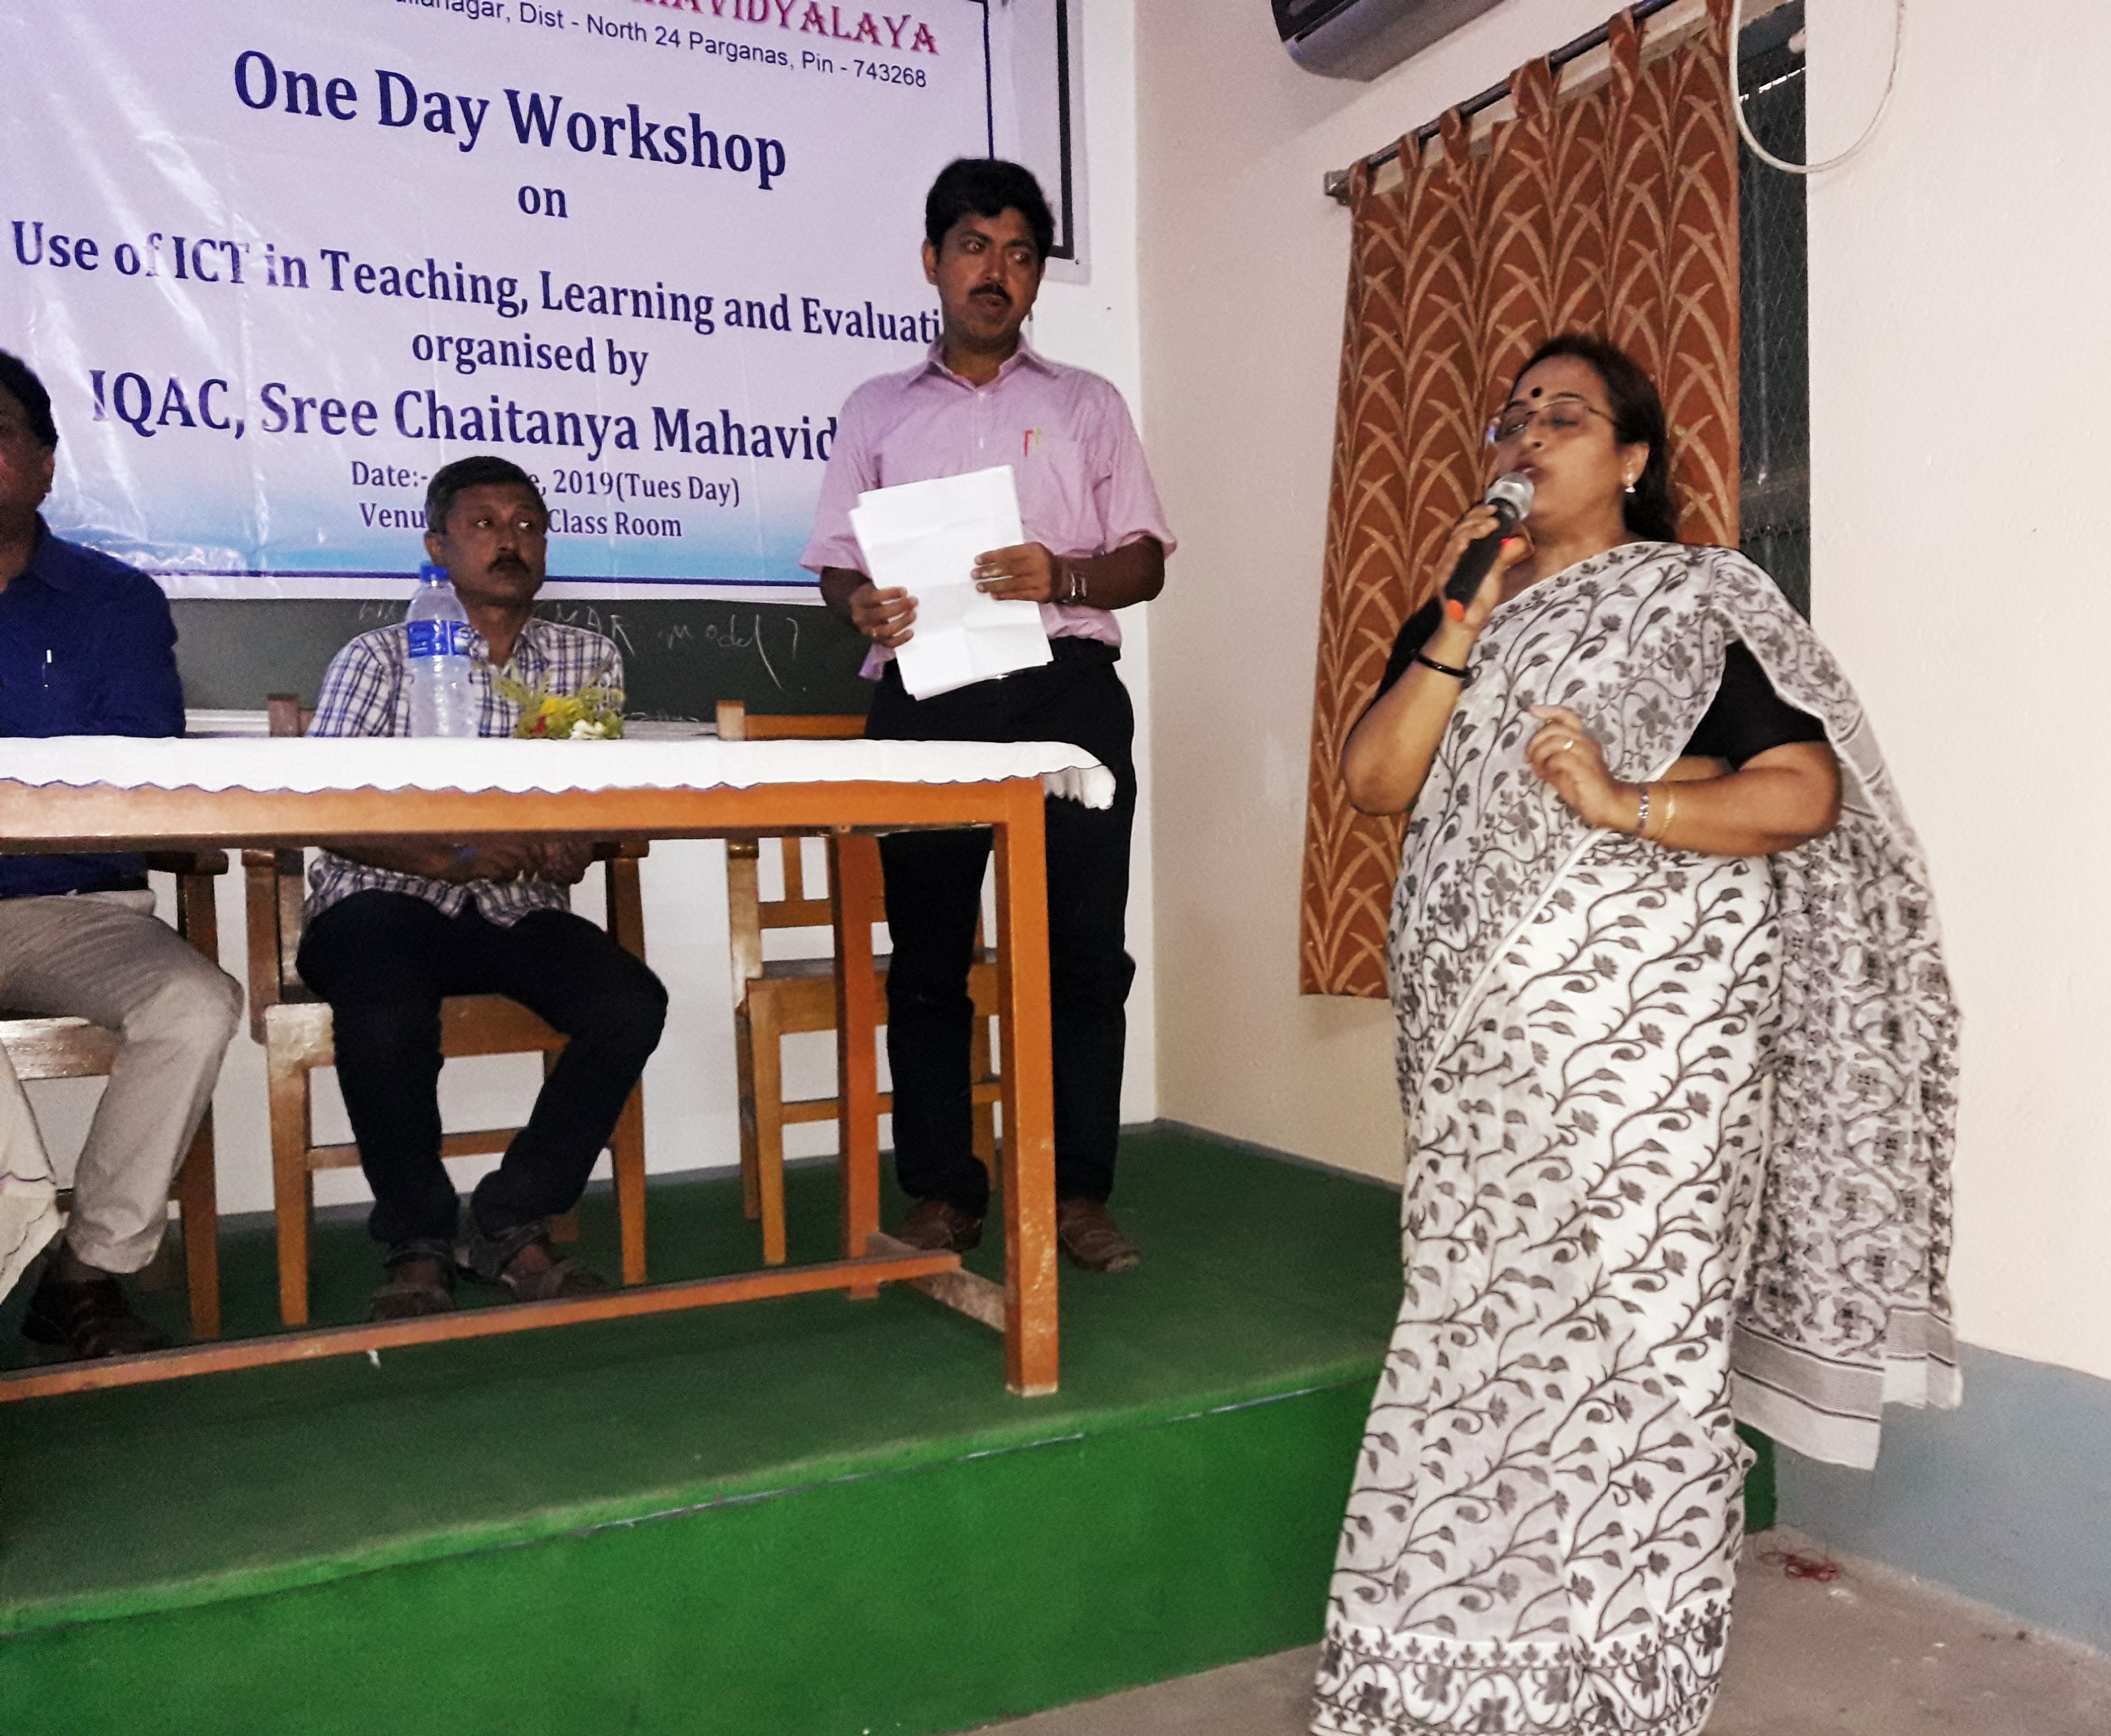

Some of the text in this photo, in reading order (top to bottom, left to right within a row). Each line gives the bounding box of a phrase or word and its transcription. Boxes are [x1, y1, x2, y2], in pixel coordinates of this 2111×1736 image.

[397, 0, 510, 22] nagar,
[520, 2, 564, 29] Dist
[587, 13, 647, 42] North
[655, 25, 681, 48] 24
[688, 30, 794, 70] Parganas,
[801, 50, 833, 73] Pin
[853, 59, 927, 88] 743268
[235, 50, 786, 190] One Day Workshop
[518, 185, 569, 219] on
[11, 220, 99, 271] Use
[113, 232, 163, 278] of
[171, 235, 250, 284] ICT
[265, 243, 310, 289] in
[320, 248, 528, 318] Teaching,
[538, 270, 715, 336] Learning
[724, 292, 793, 332] and
[412, 332, 649, 386] organised by
[89, 369, 837, 461] IQAC, Sree Chaitanya Mahavid
[350, 460, 428, 488] Date:-
[553, 469, 682, 503] 2019(Tues
[687, 476, 740, 508] Day)
[547, 509, 608, 534] Class
[614, 511, 683, 537] Room
